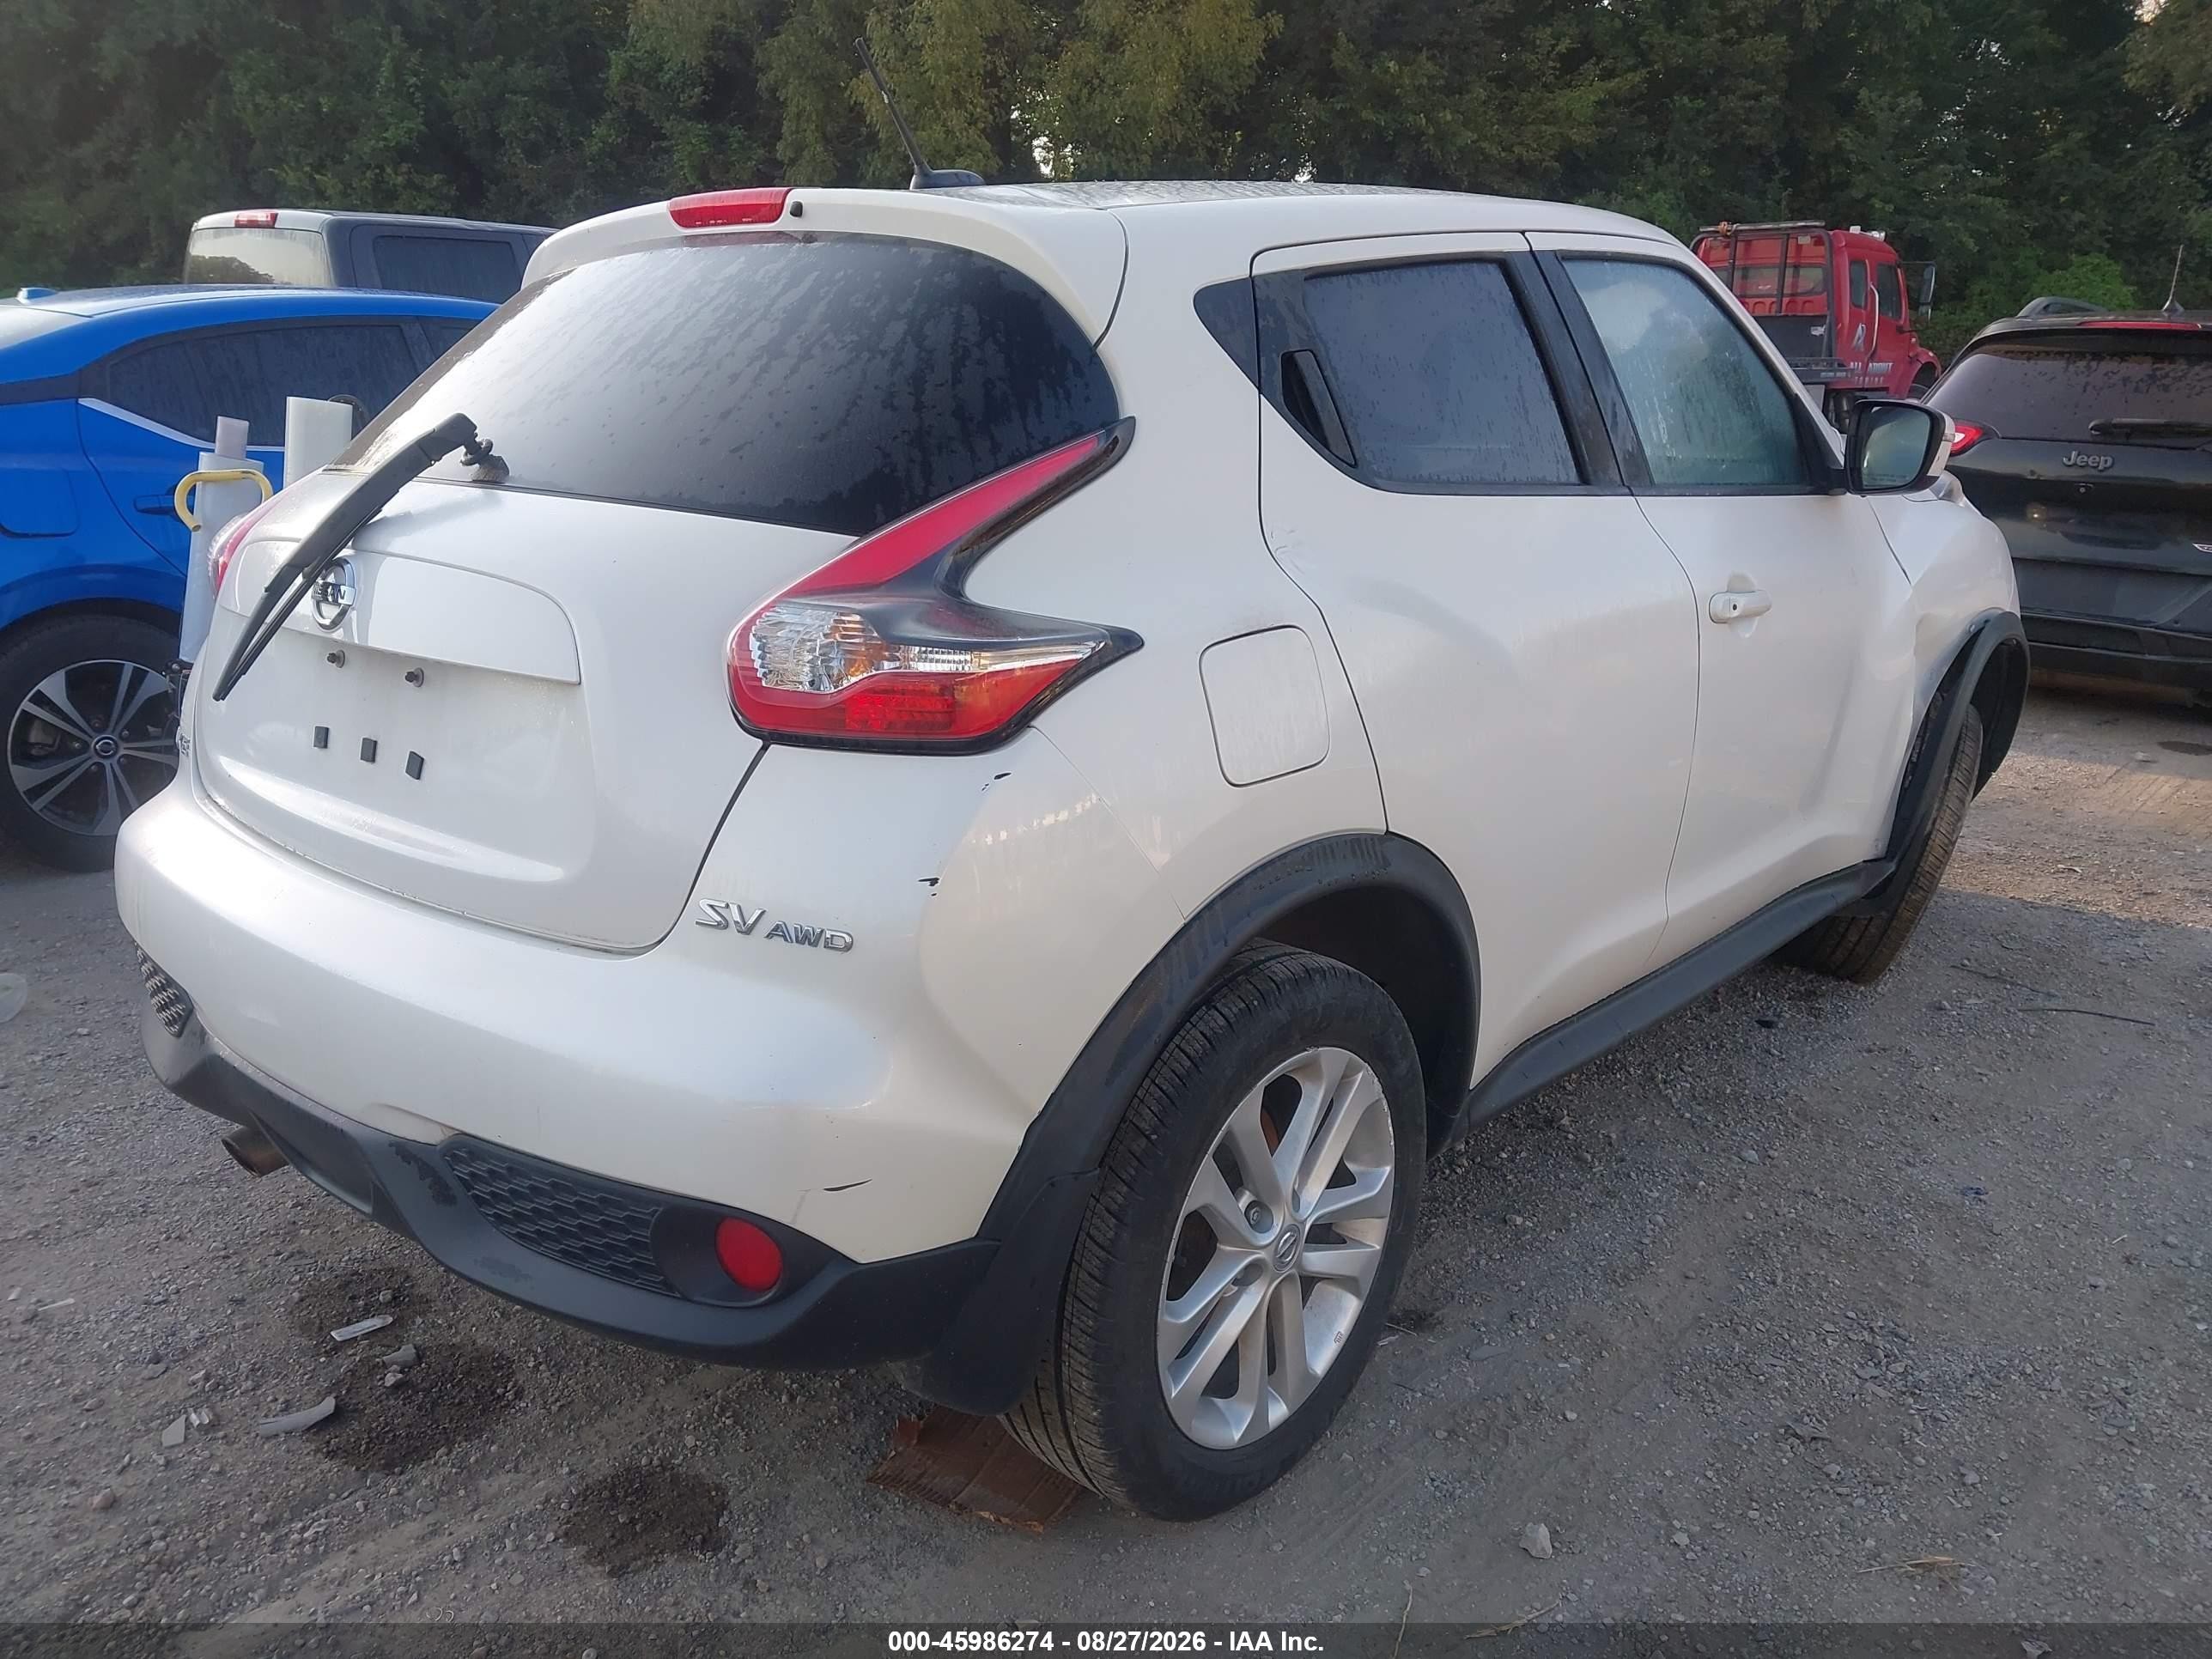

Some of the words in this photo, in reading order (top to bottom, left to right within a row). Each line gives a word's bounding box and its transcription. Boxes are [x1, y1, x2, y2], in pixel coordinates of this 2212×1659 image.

[2063, 451, 2114, 471] Jeep
[695, 898, 767, 935] SV
[763, 921, 854, 953] AWD
